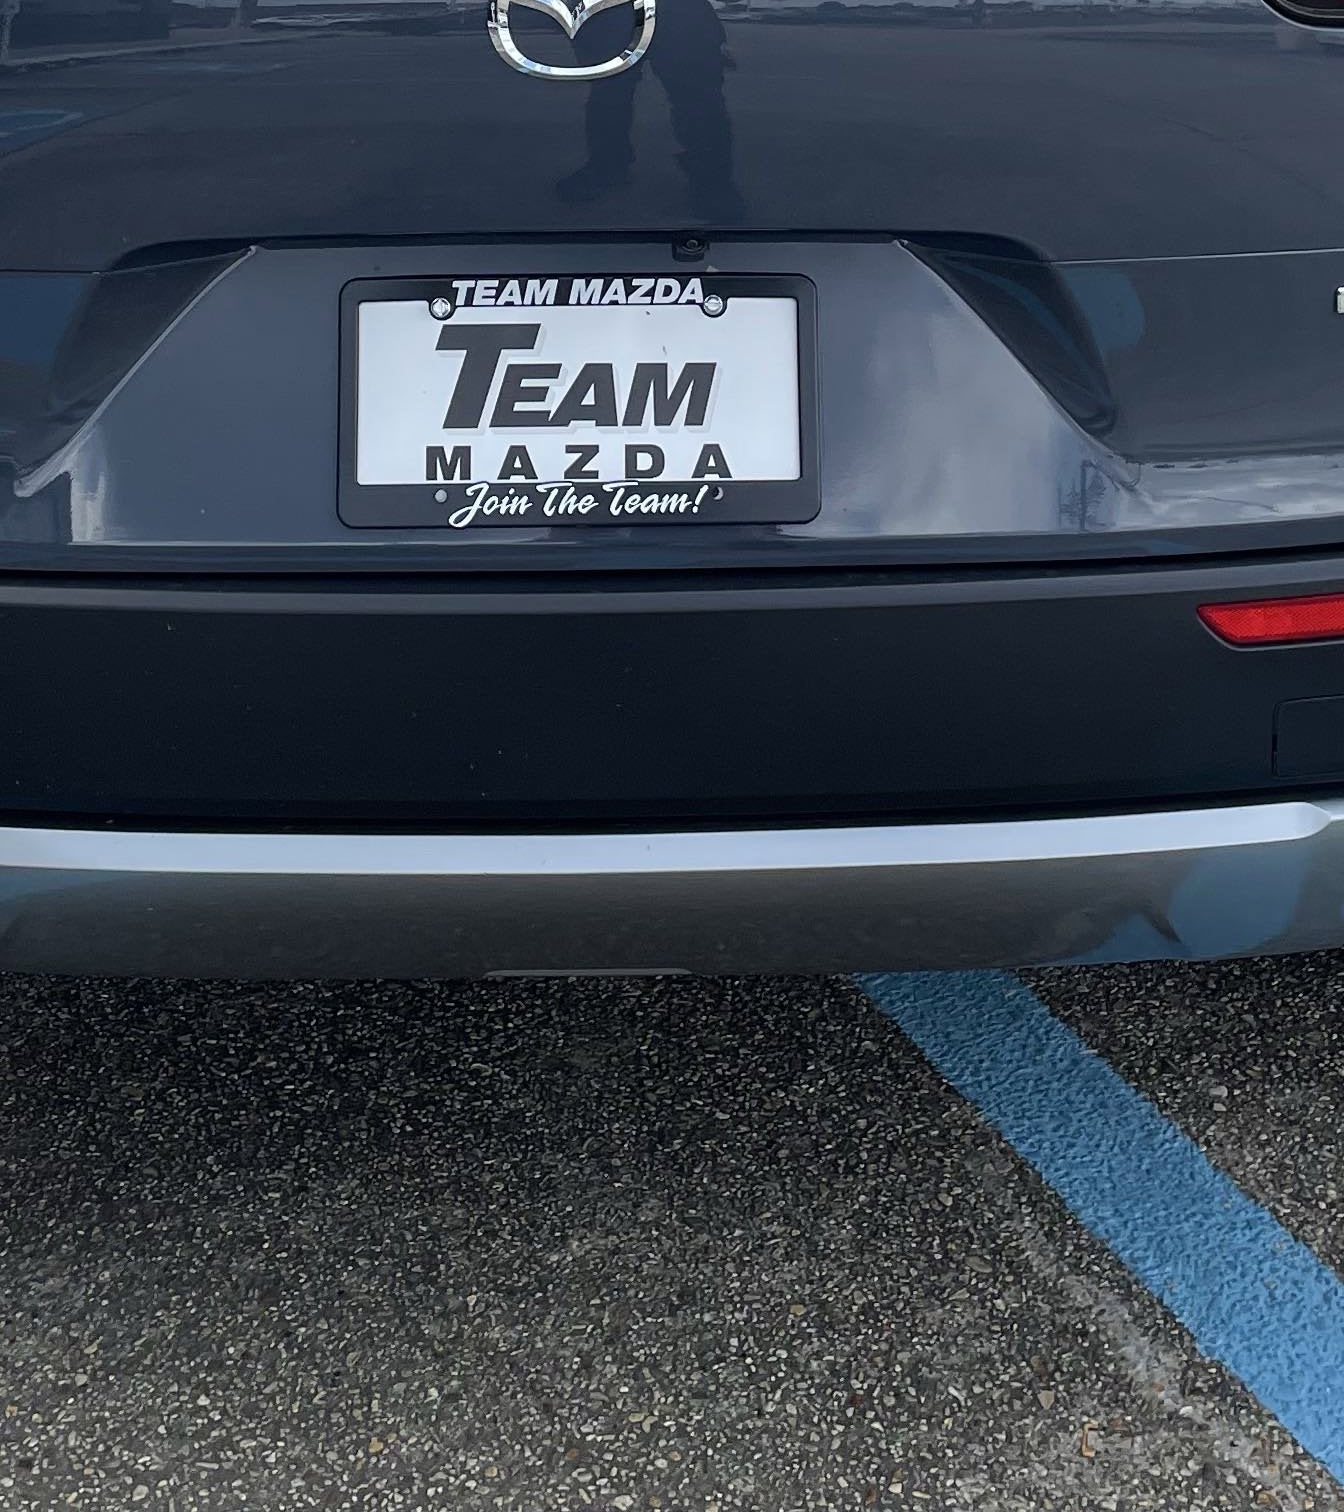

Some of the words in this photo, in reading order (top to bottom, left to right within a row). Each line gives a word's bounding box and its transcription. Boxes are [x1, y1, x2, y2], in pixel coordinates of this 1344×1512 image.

[452, 279, 558, 307] TEAM
[568, 277, 704, 305] MAZDA
[435, 323, 720, 430] TEAM
[425, 443, 734, 481] MAZDA
[448, 481, 533, 528] Join
[536, 481, 599, 517] The
[602, 480, 709, 516] Team!
